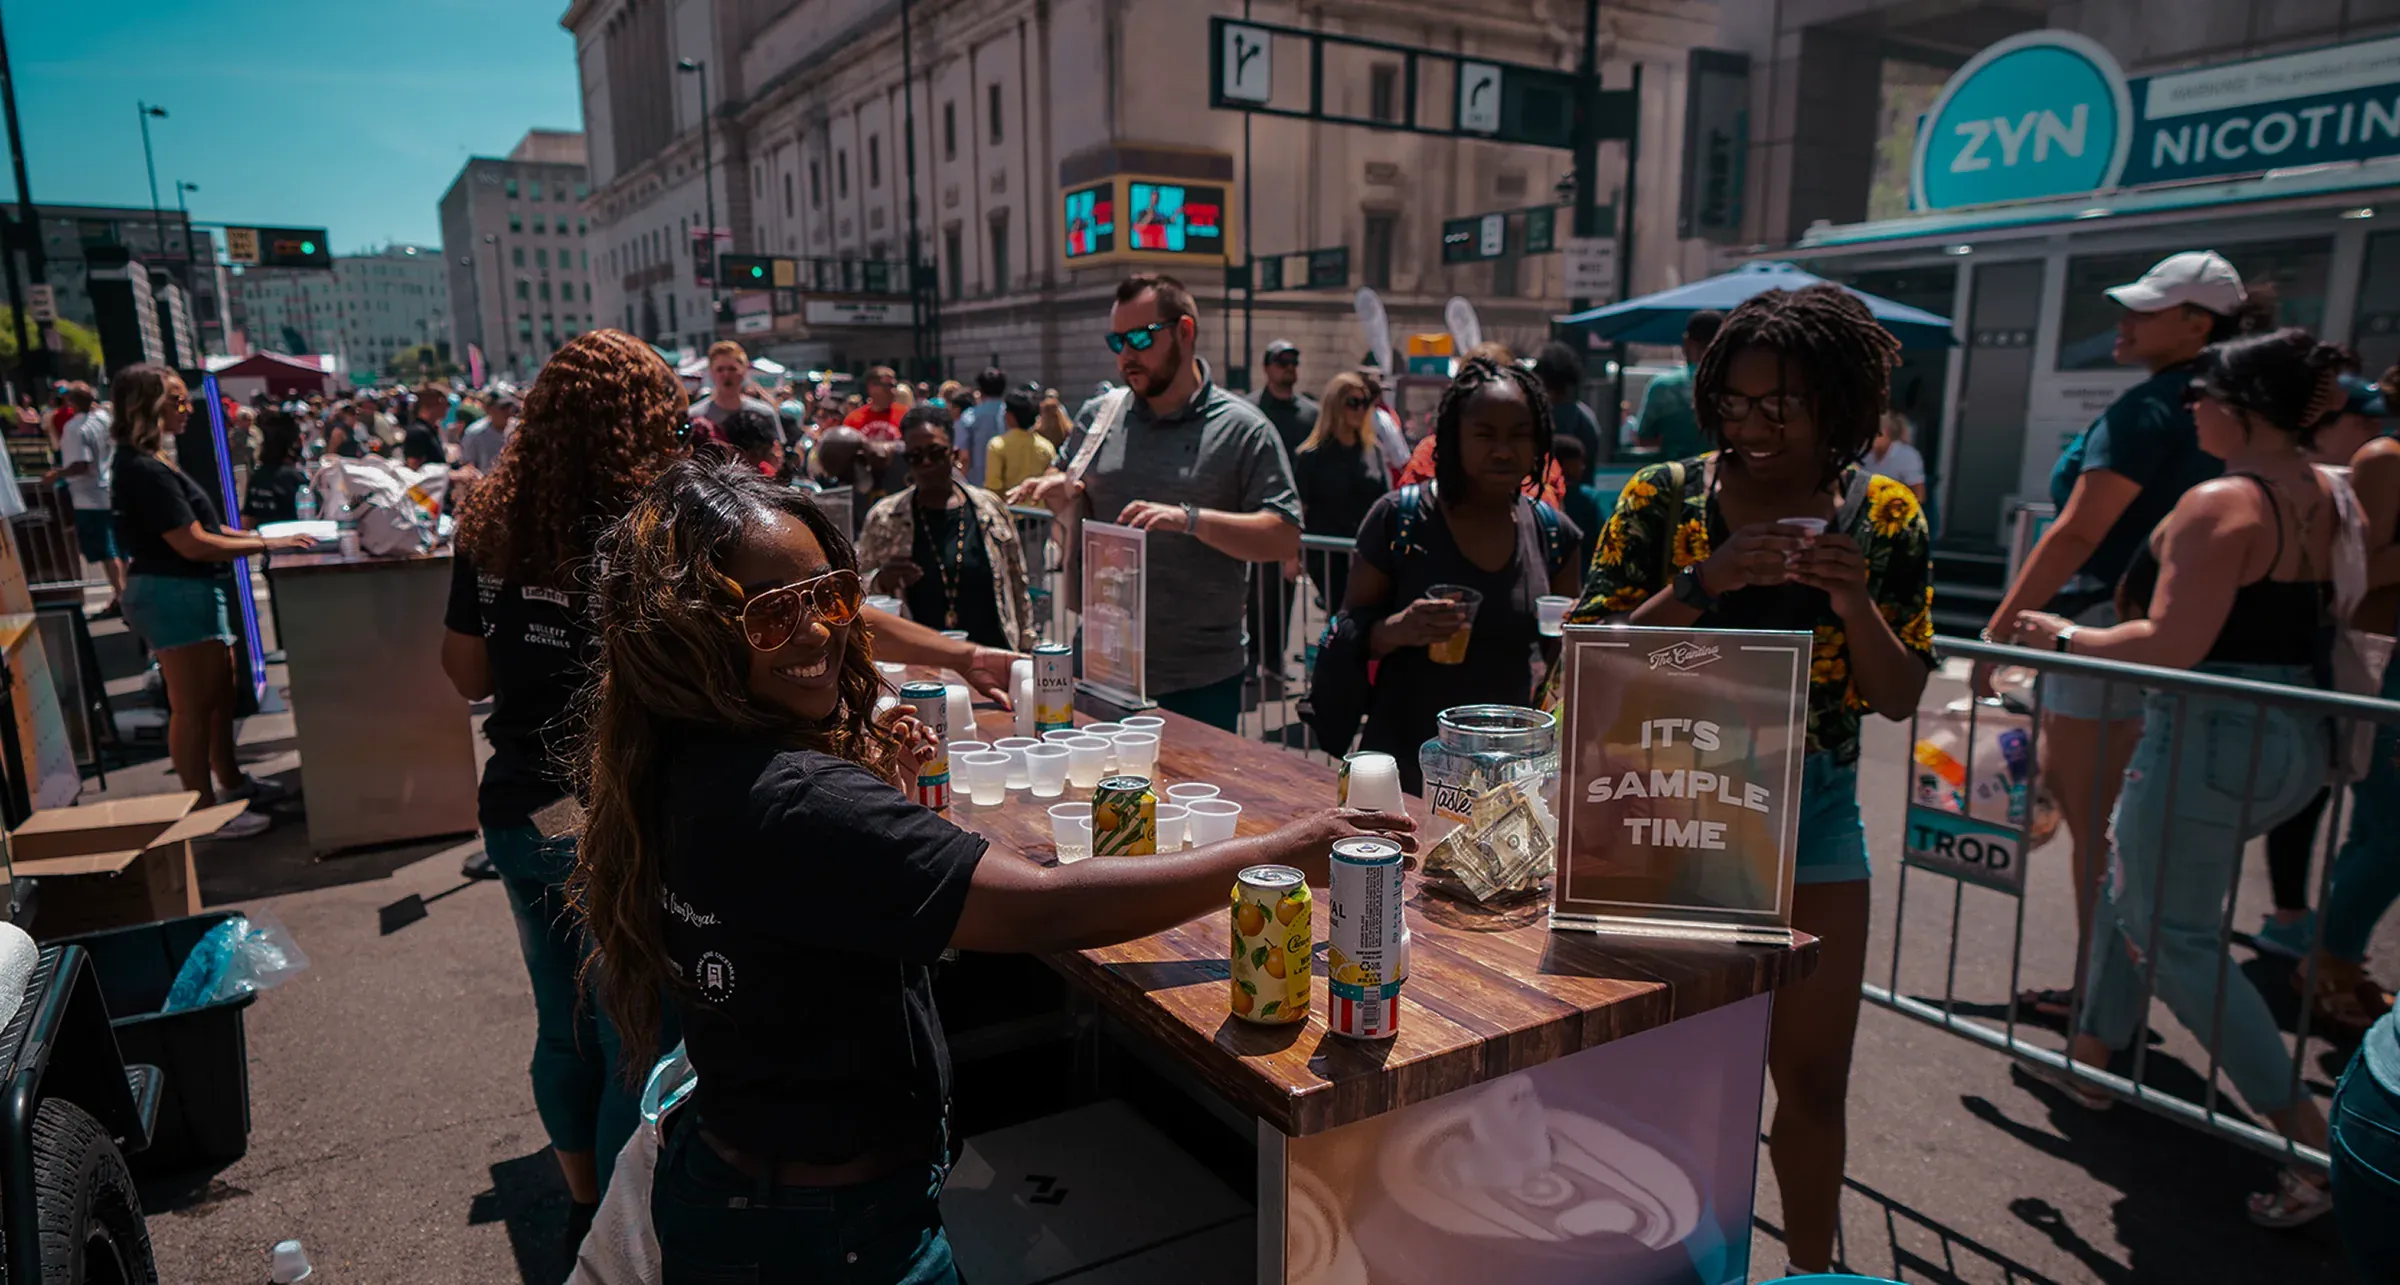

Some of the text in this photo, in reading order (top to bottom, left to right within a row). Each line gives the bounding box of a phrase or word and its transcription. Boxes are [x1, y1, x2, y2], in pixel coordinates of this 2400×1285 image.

[1950, 103, 2089, 173] ZYN
[2152, 97, 2400, 169] NICOTIN
[524, 633, 571, 649] COCKTAILS
[528, 623, 567, 638] BULLEIT
[1649, 645, 1720, 671] The Cantina
[1037, 677, 1068, 688] LOYAL
[1641, 718, 1721, 751] IT'S
[1427, 779, 1476, 815] Taste
[1586, 769, 1770, 814] SAMPLE
[1623, 818, 1728, 850] TIME
[1912, 824, 2011, 870] TROD
